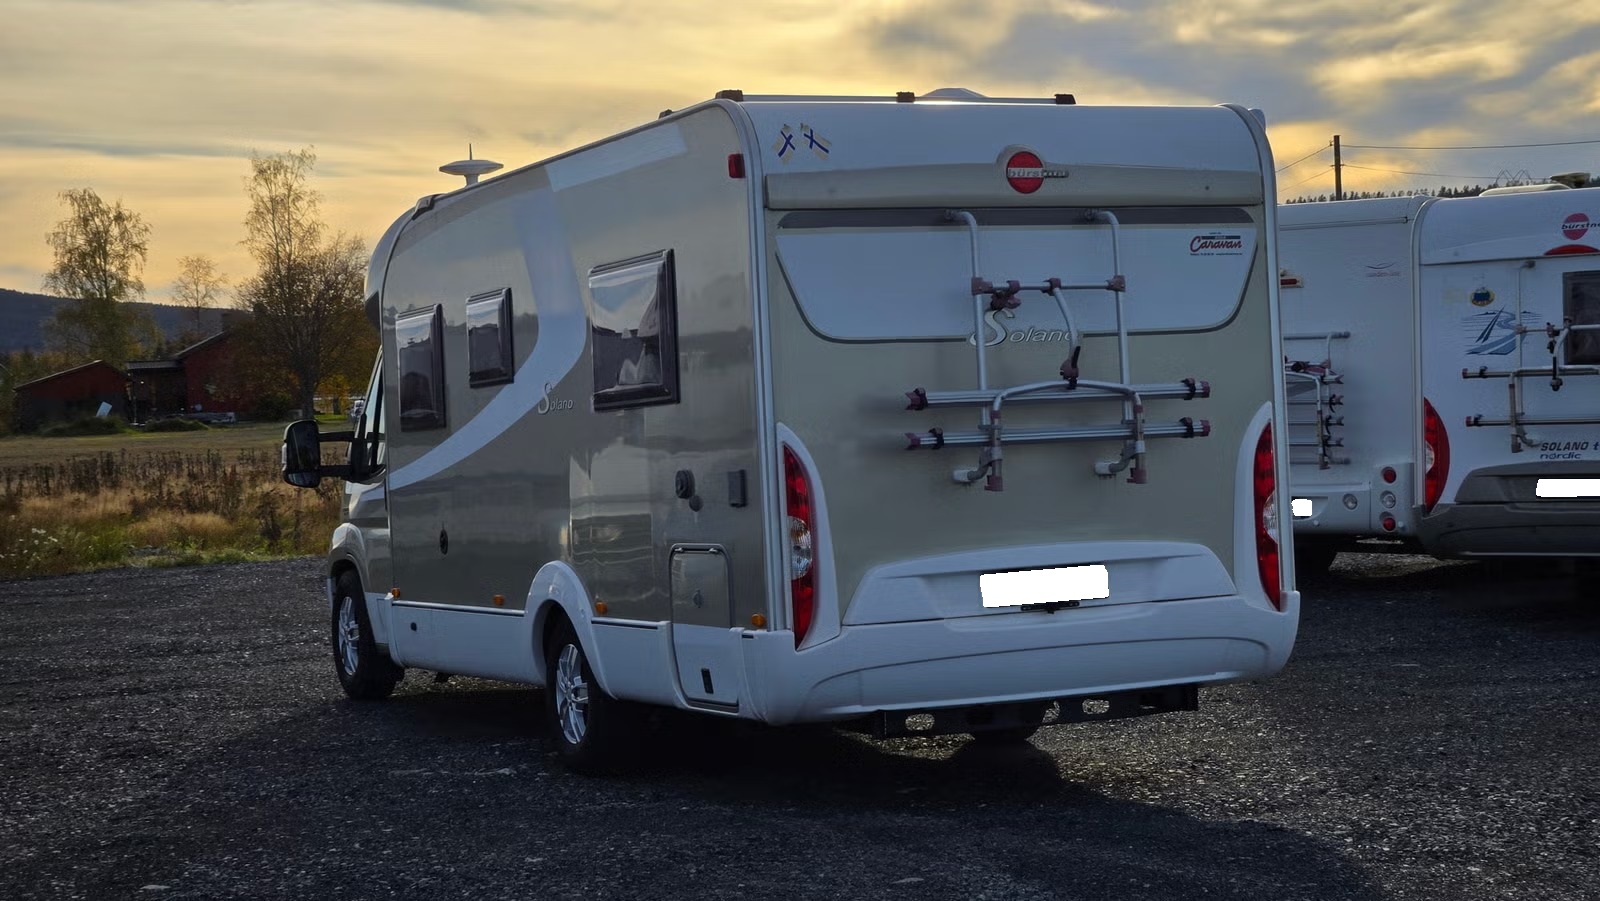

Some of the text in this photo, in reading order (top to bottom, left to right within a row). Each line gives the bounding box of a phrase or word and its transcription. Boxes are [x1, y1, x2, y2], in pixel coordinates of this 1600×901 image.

[1190, 235, 1242, 252] Caravan
[537, 382, 574, 415] Solano
[1541, 441, 1589, 451] SOLANO
